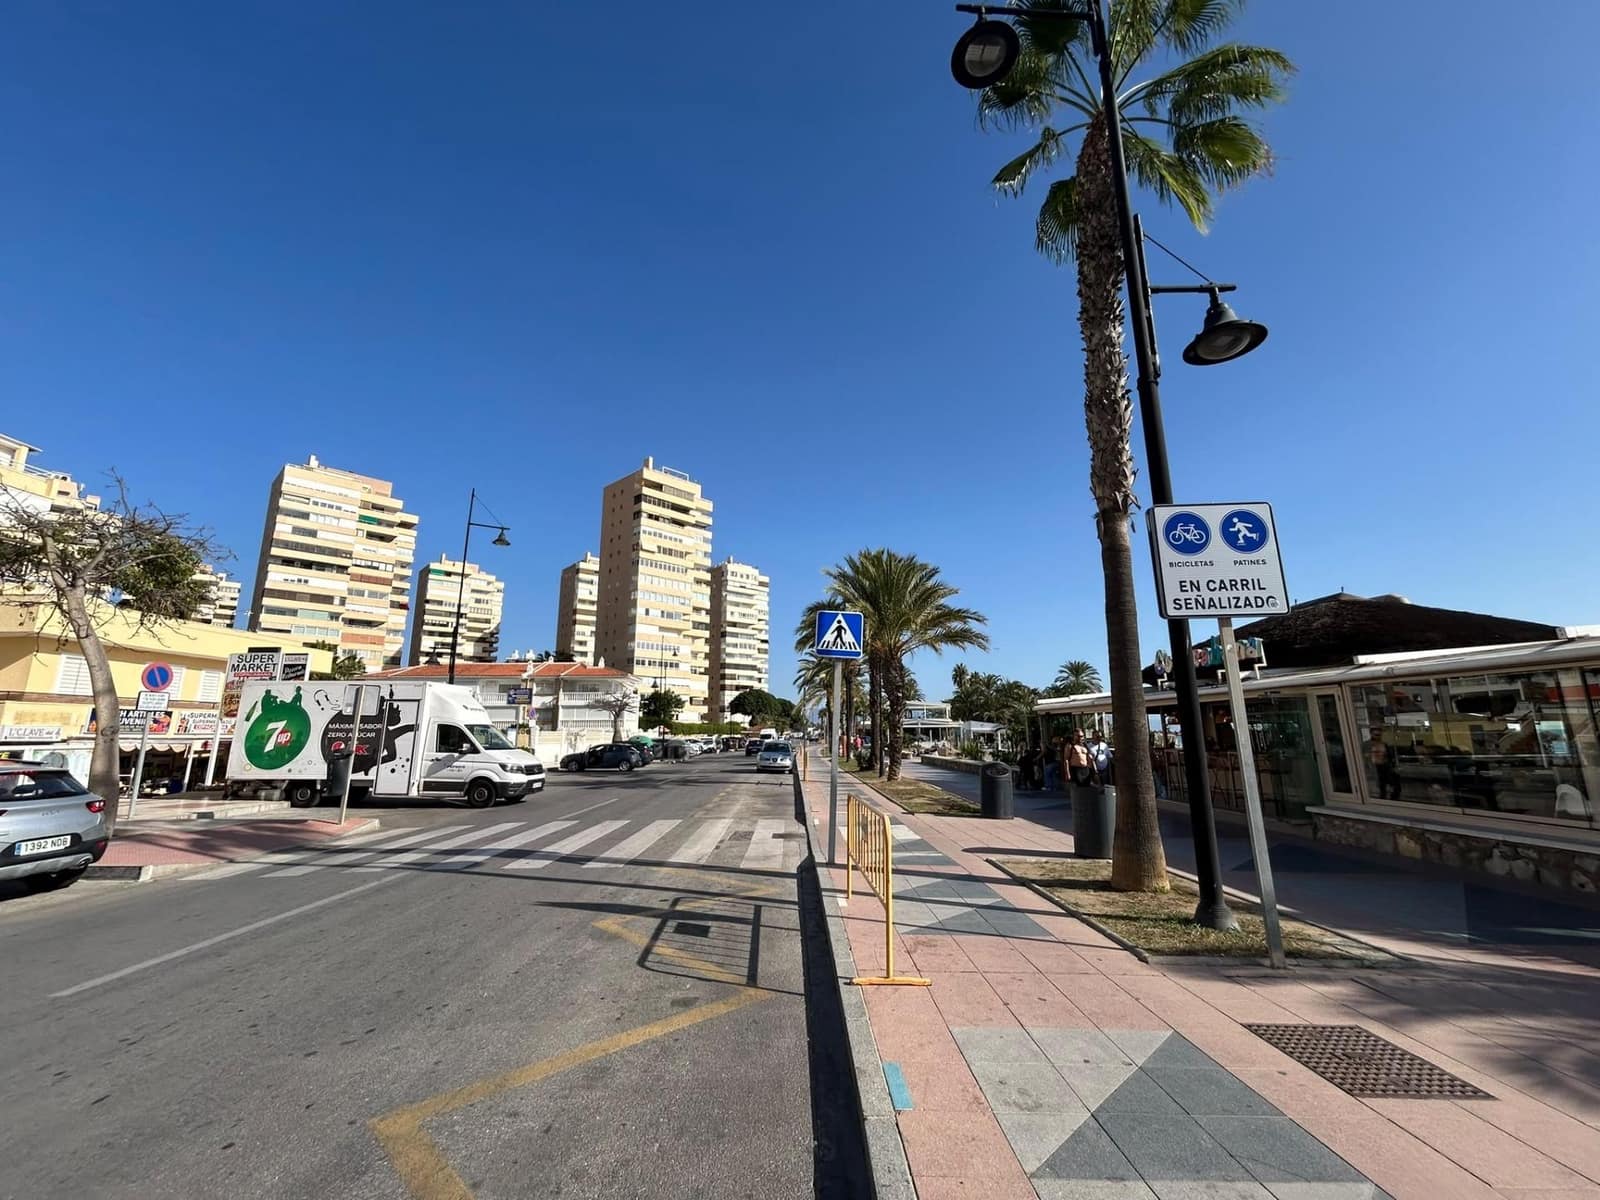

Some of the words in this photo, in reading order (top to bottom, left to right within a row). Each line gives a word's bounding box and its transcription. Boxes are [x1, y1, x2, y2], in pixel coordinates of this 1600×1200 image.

[1168, 560, 1215, 568] BICICLETAS
[1179, 579, 1201, 592] EN
[1206, 578, 1266, 592] CARRIL
[237, 654, 275, 663] SUPER
[231, 663, 278, 672] MARKET
[127, 710, 165, 718] ARTILES
[25, 840, 49, 852] 1392
